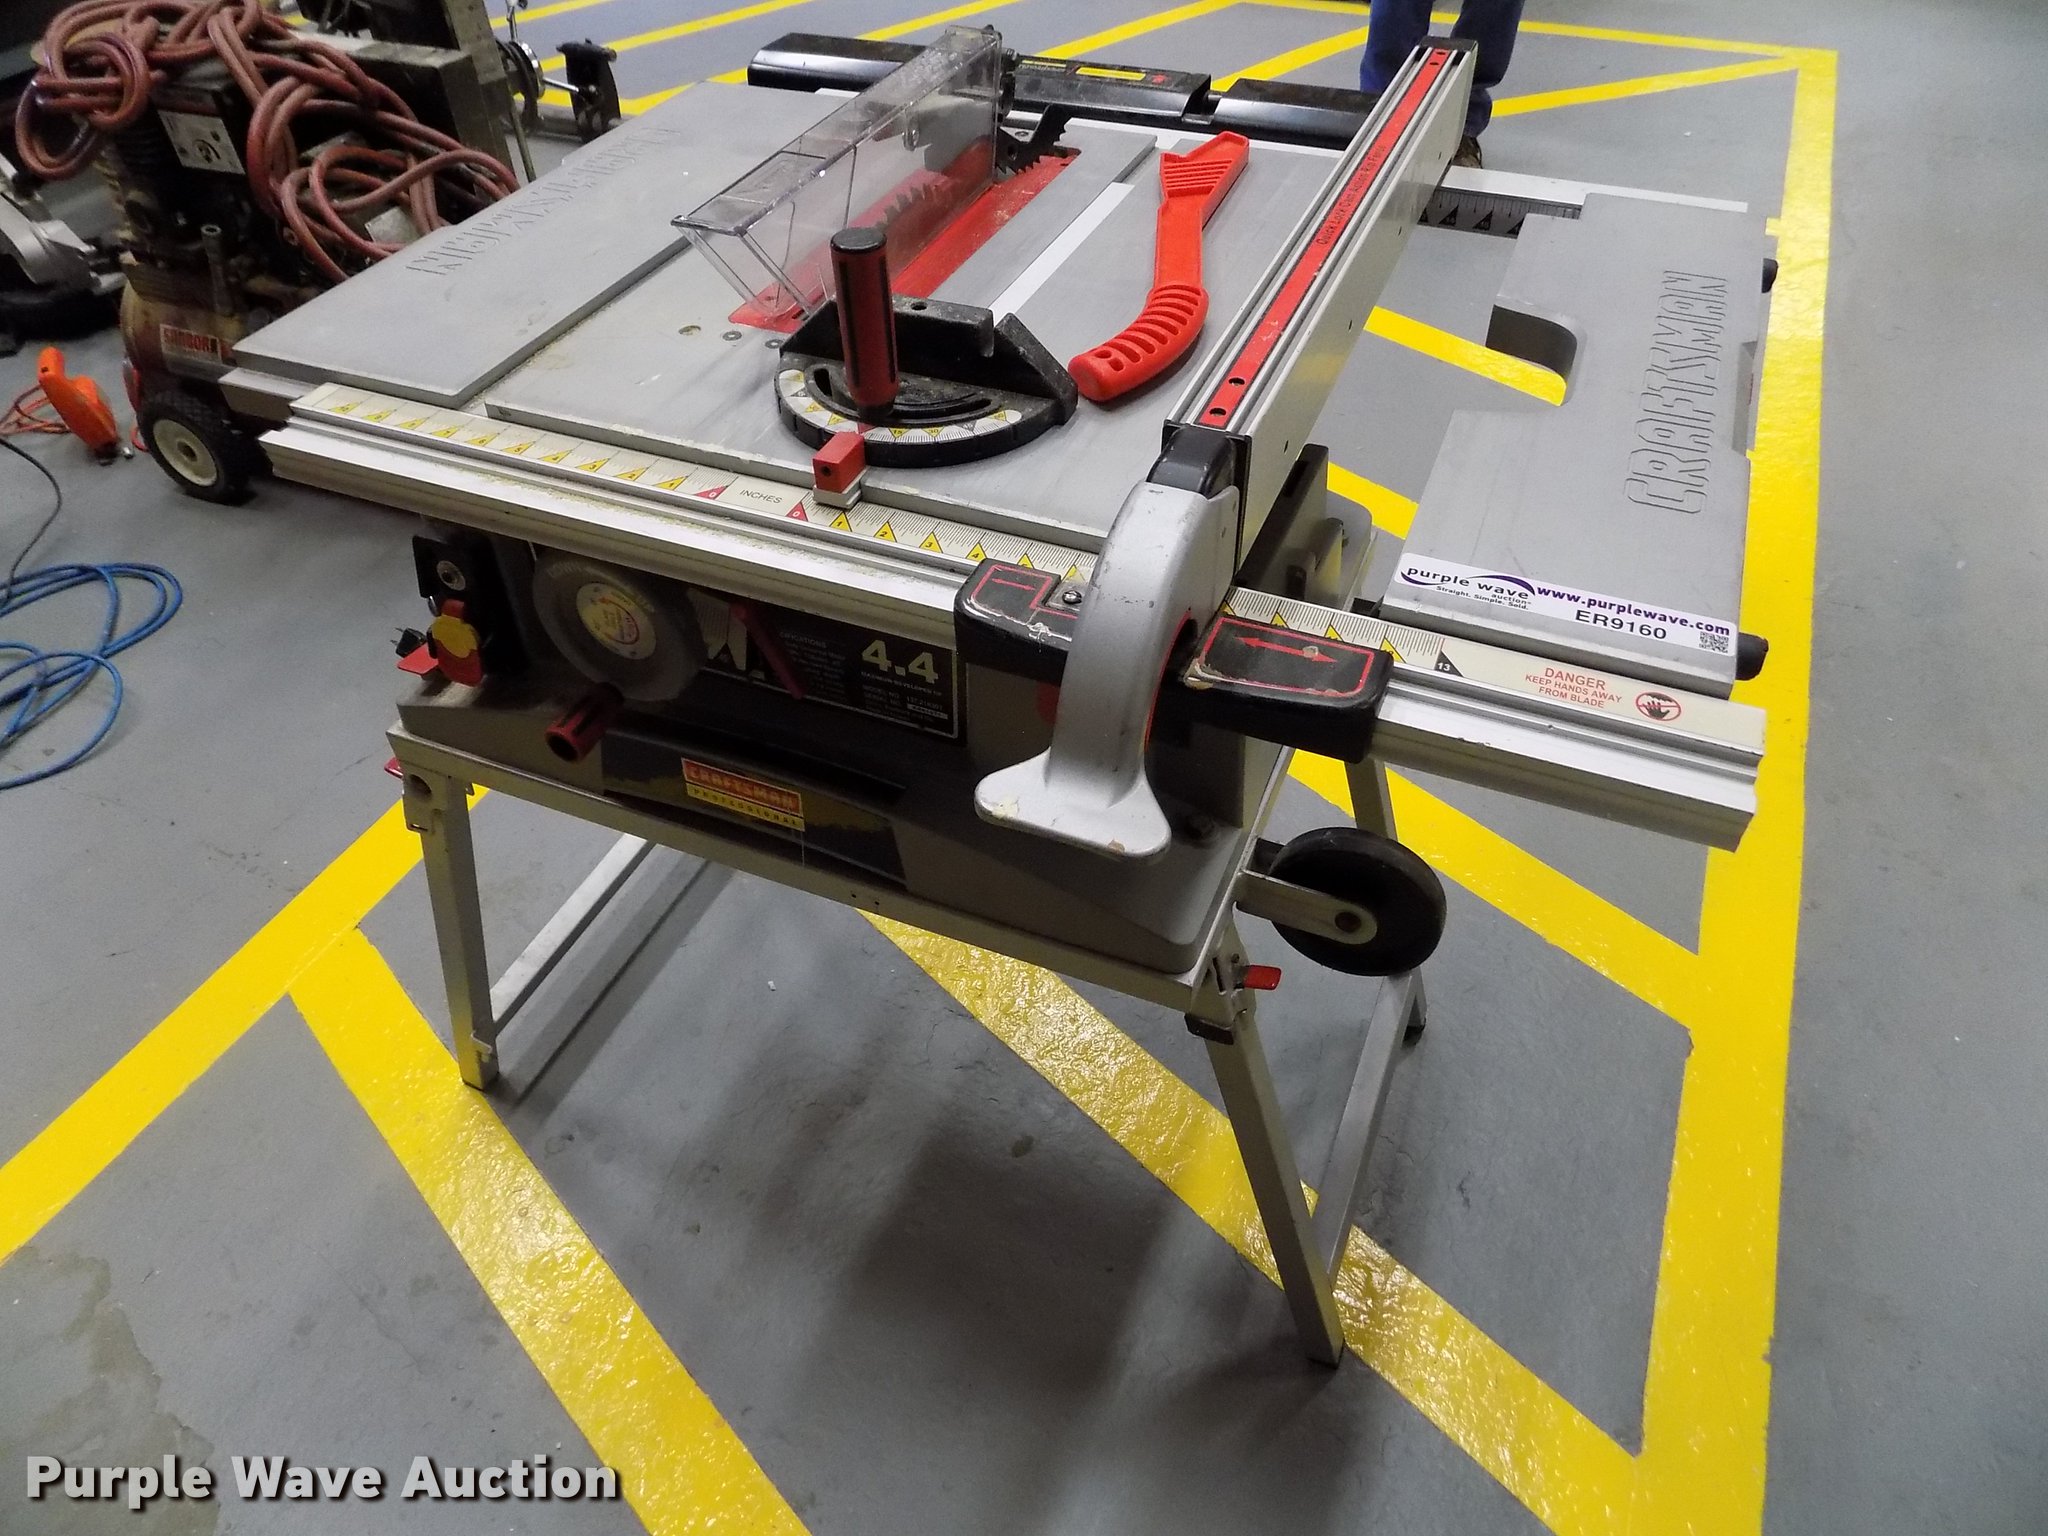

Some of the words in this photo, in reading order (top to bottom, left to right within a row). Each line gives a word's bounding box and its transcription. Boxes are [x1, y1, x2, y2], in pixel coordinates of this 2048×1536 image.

[1623, 270, 1728, 514] CRAFTSMAN
[740, 489, 783, 504] INCHES
[1406, 567, 1470, 587] purple
[1477, 582, 1530, 600] wave
[1536, 586, 1730, 636] www.purplewave.com
[1575, 609, 1667, 640] ER9160
[861, 639, 939, 684] 4.4
[1437, 662, 1451, 672] 13
[1525, 674, 1552, 686] KEEP
[1554, 681, 1589, 696] HANDS
[1591, 690, 1622, 704] AWAY
[1544, 667, 1606, 691] DANGER
[1538, 686, 1568, 700] FROM
[1570, 693, 1605, 709] BLADE
[685, 763, 798, 812] CRAFTSMAN
